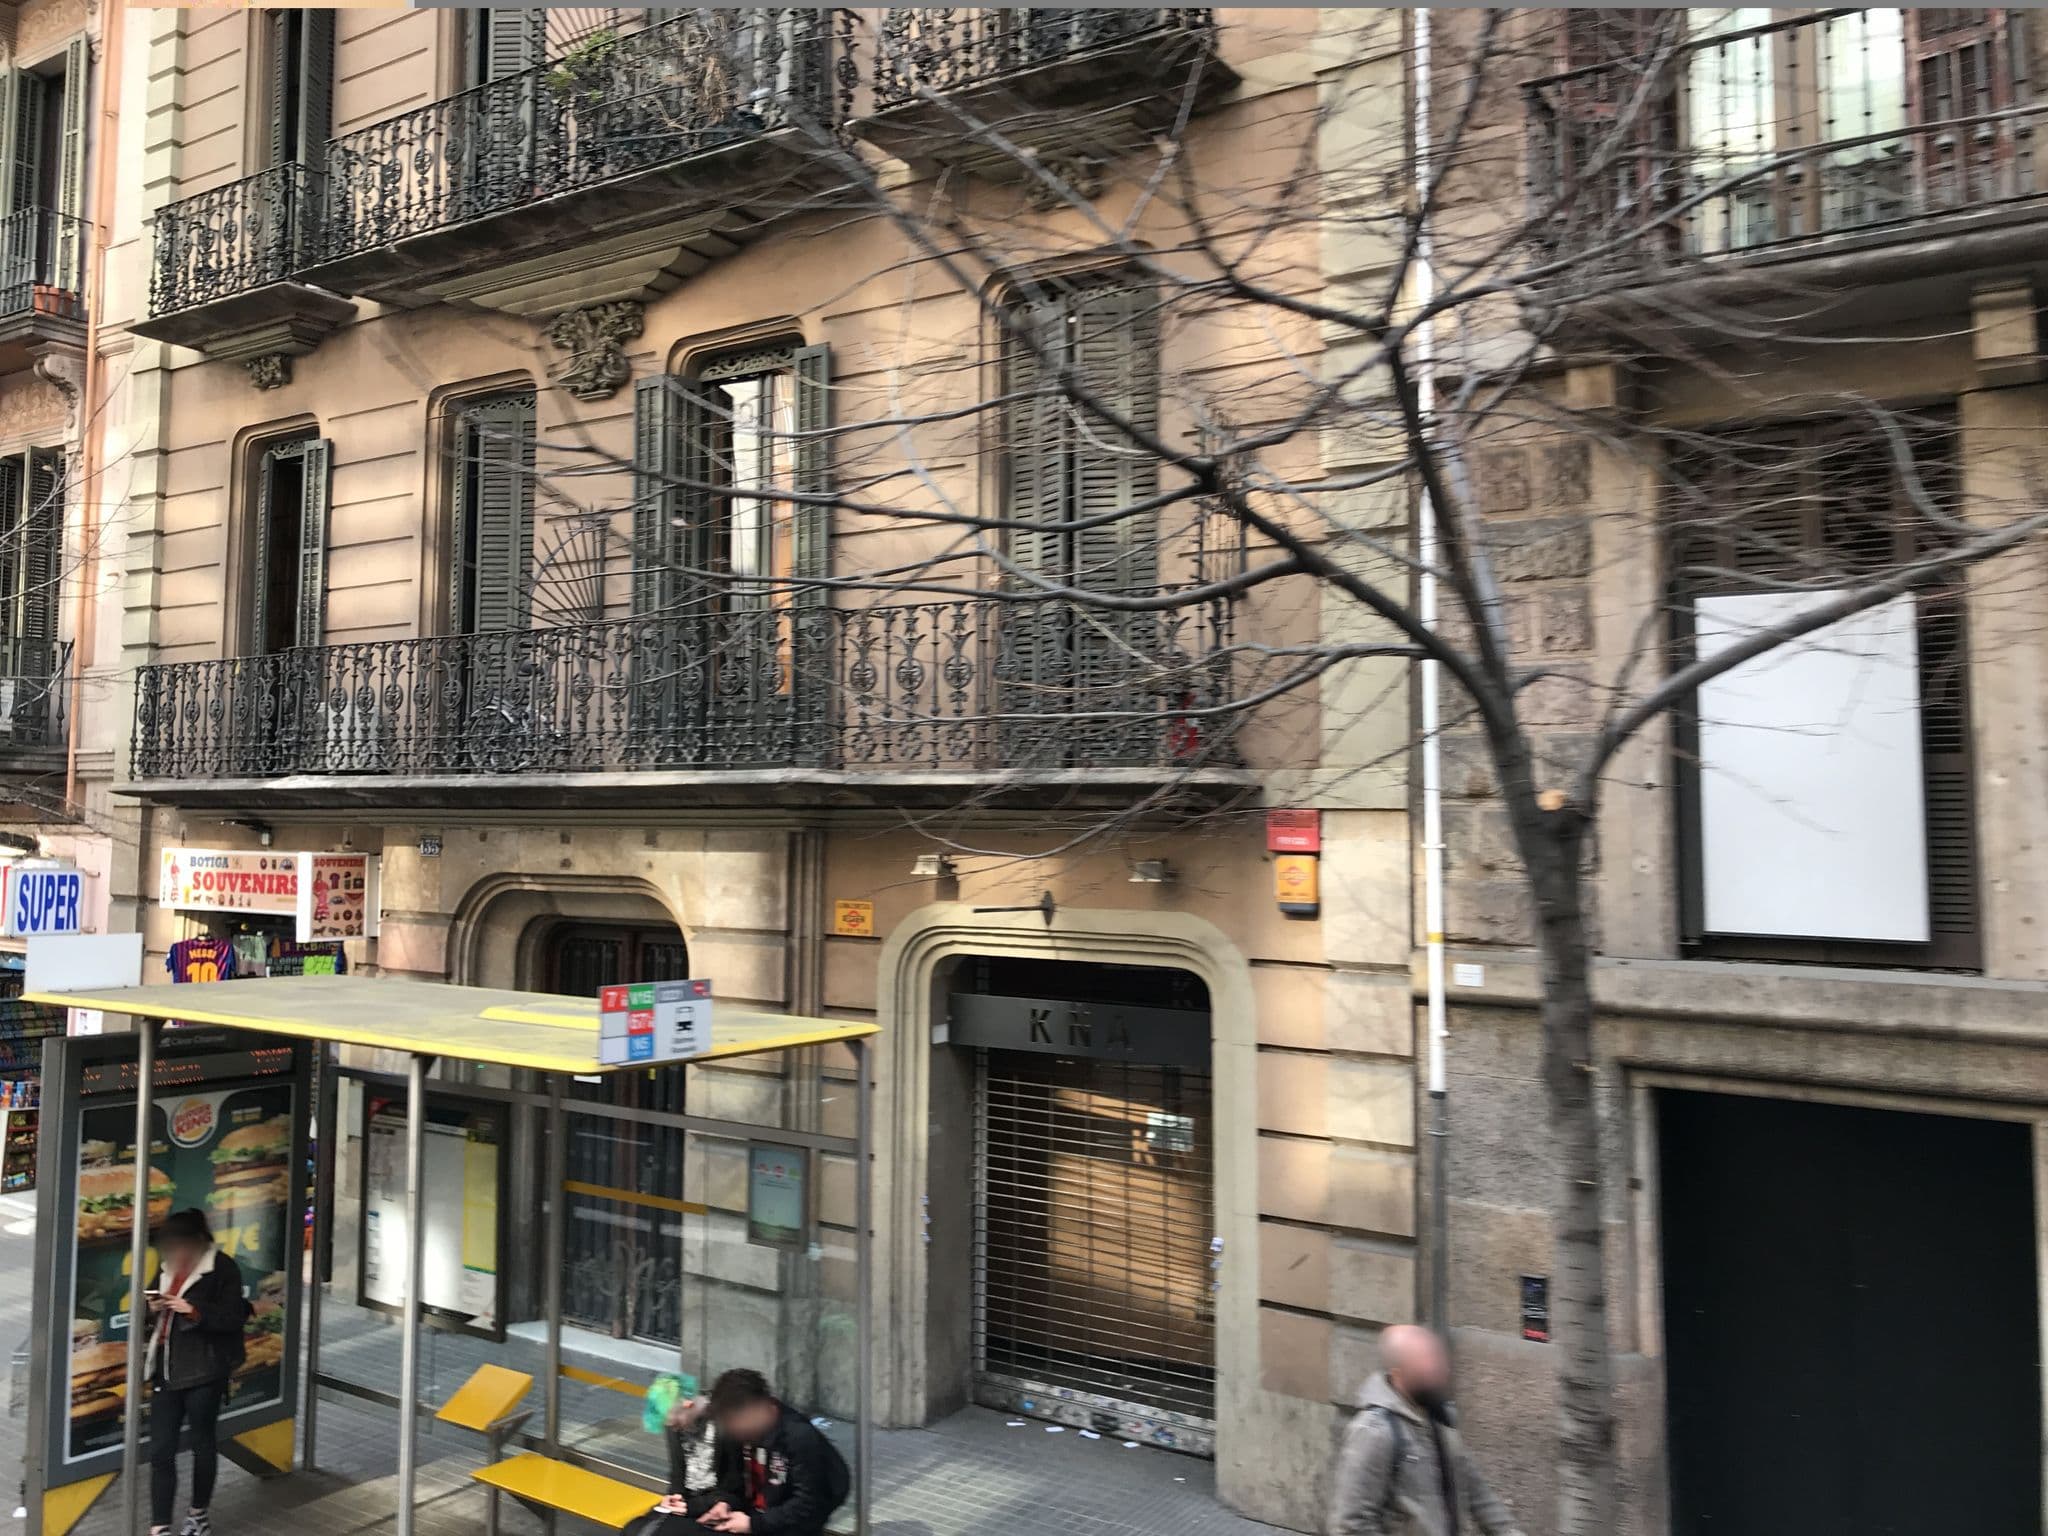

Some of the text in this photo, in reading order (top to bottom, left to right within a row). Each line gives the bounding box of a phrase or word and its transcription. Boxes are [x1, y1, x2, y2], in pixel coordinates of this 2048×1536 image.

[190, 856, 229, 868] BOTIGA
[314, 858, 364, 867] SOUVENIRS
[192, 871, 298, 896] SOUVENIRS
[17, 873, 80, 932] SUPER
[188, 947, 218, 960] MESSI
[186, 961, 218, 982] 10
[175, 1114, 212, 1137] KING
